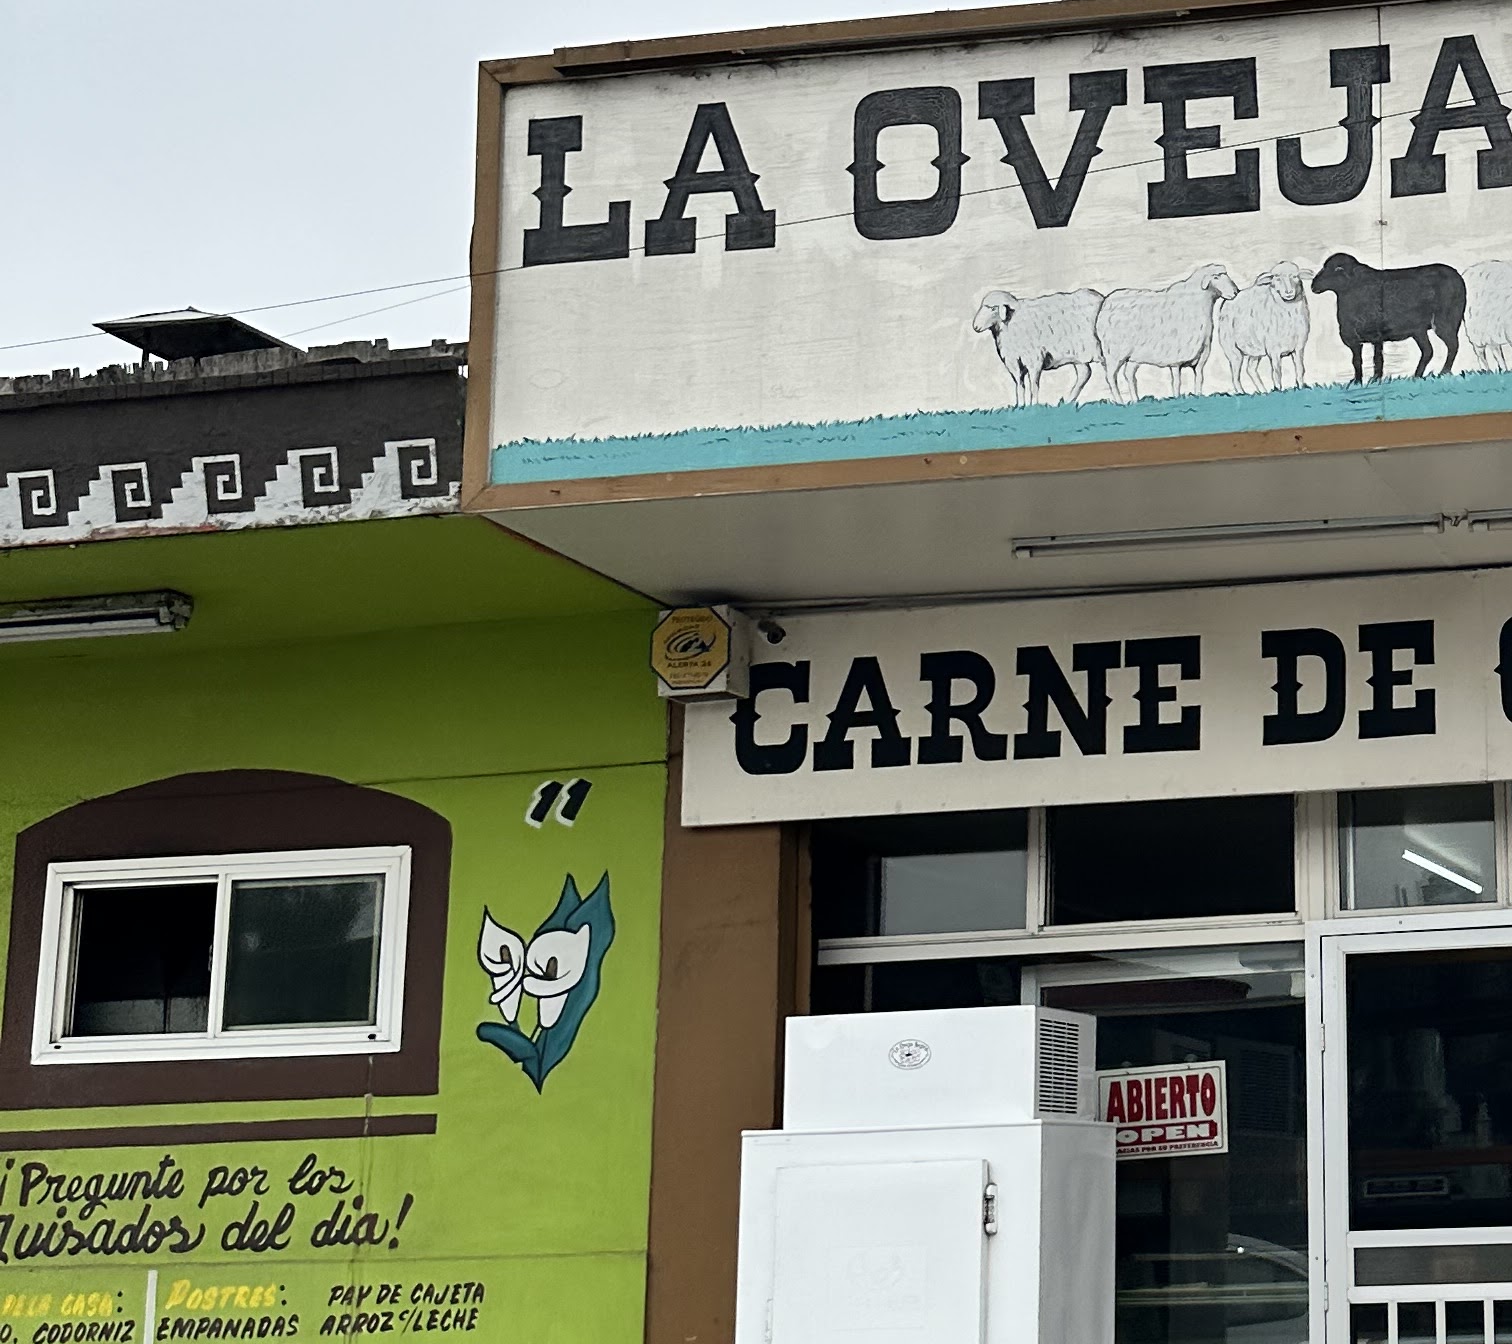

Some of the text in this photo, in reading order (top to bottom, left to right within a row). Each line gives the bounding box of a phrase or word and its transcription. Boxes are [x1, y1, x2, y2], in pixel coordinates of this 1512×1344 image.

[524, 102, 776, 267] LA
[729, 635, 1202, 775] CARNE
[1261, 620, 1437, 746] DE
[525, 778, 592, 828] 11
[1106, 1072, 1216, 1124] ABIERTO
[1116, 1123, 1210, 1144] OPEN
[198, 1166, 270, 1208] por
[288, 1153, 354, 1195] los
[221, 1201, 296, 1252] del
[327, 1282, 486, 1309] PAY DE CAJETA
[156, 1314, 300, 1341] EMPANADAS
[319, 1311, 395, 1336] ARROZ
